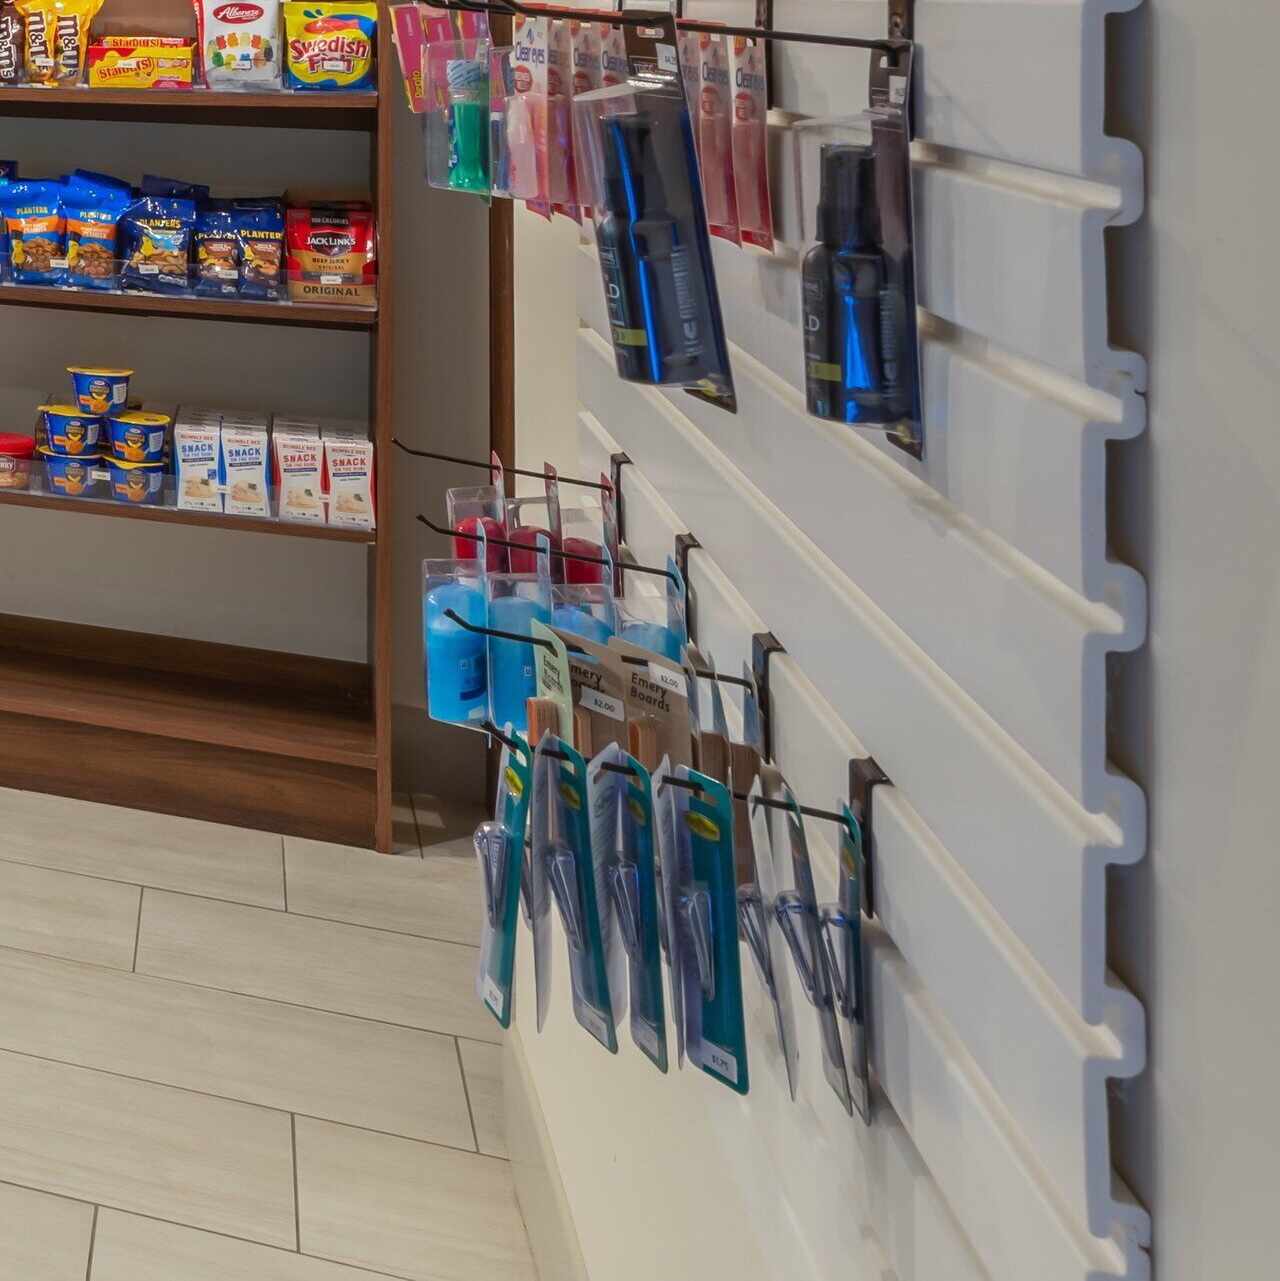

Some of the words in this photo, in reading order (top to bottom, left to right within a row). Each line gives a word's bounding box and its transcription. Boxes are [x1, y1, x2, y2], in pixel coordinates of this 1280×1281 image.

[219, 7, 261, 23] Albanese
[290, 36, 369, 60] Swedish
[515, 43, 531, 61] Clear
[532, 46, 546, 65] eyes
[306, 237, 329, 246] JACK
[303, 285, 360, 297] ORIGINAL
[181, 444, 213, 453] SNACK
[228, 448, 261, 457] SNACK
[283, 454, 316, 463] SNACK
[332, 458, 366, 467] SNACK
[543, 656, 560, 676] Emery
[632, 673, 666, 697] Emery
[660, 675, 679, 688] $2.00
[594, 700, 614, 712] $2.00
[630, 687, 670, 713] Boards
[711, 1054, 729, 1070] $1.75
